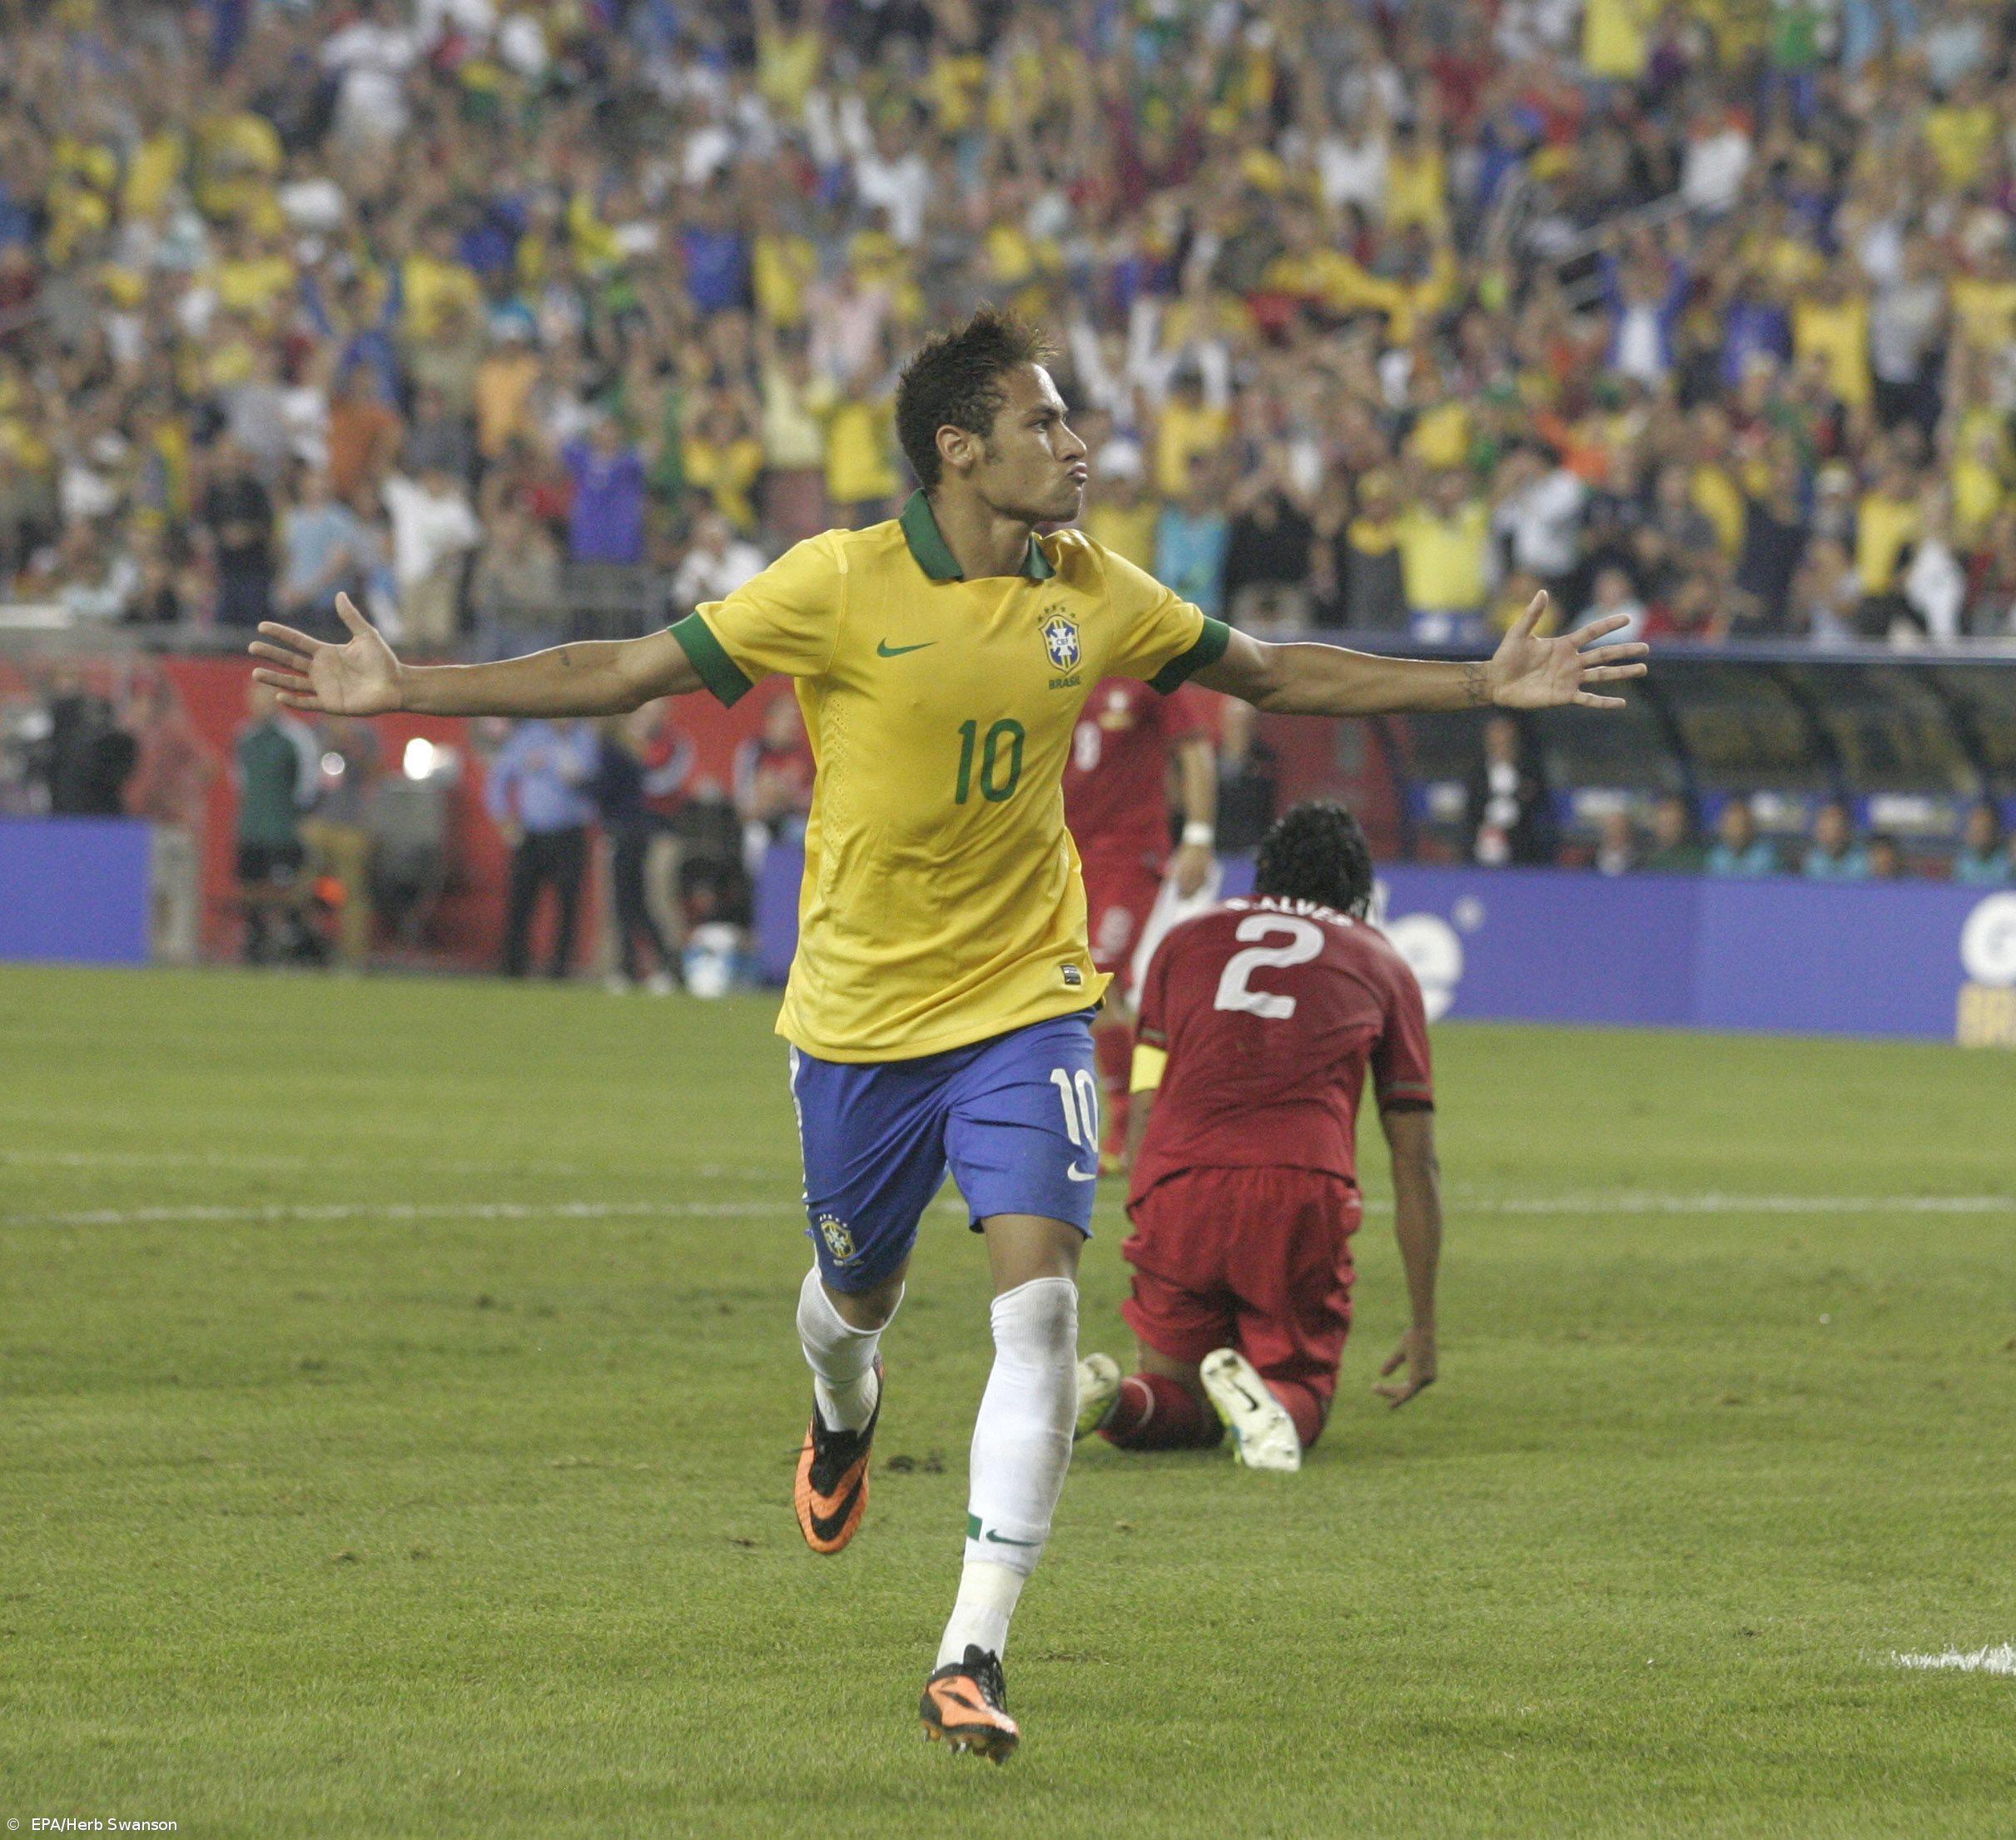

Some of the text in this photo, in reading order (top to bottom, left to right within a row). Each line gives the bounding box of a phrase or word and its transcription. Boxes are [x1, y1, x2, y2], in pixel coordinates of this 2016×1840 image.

[1049, 675, 1080, 689] BRASIL
[955, 718, 1025, 805] 10
[1214, 913, 1325, 1020] 2
[1050, 1068, 1099, 1153] 10
